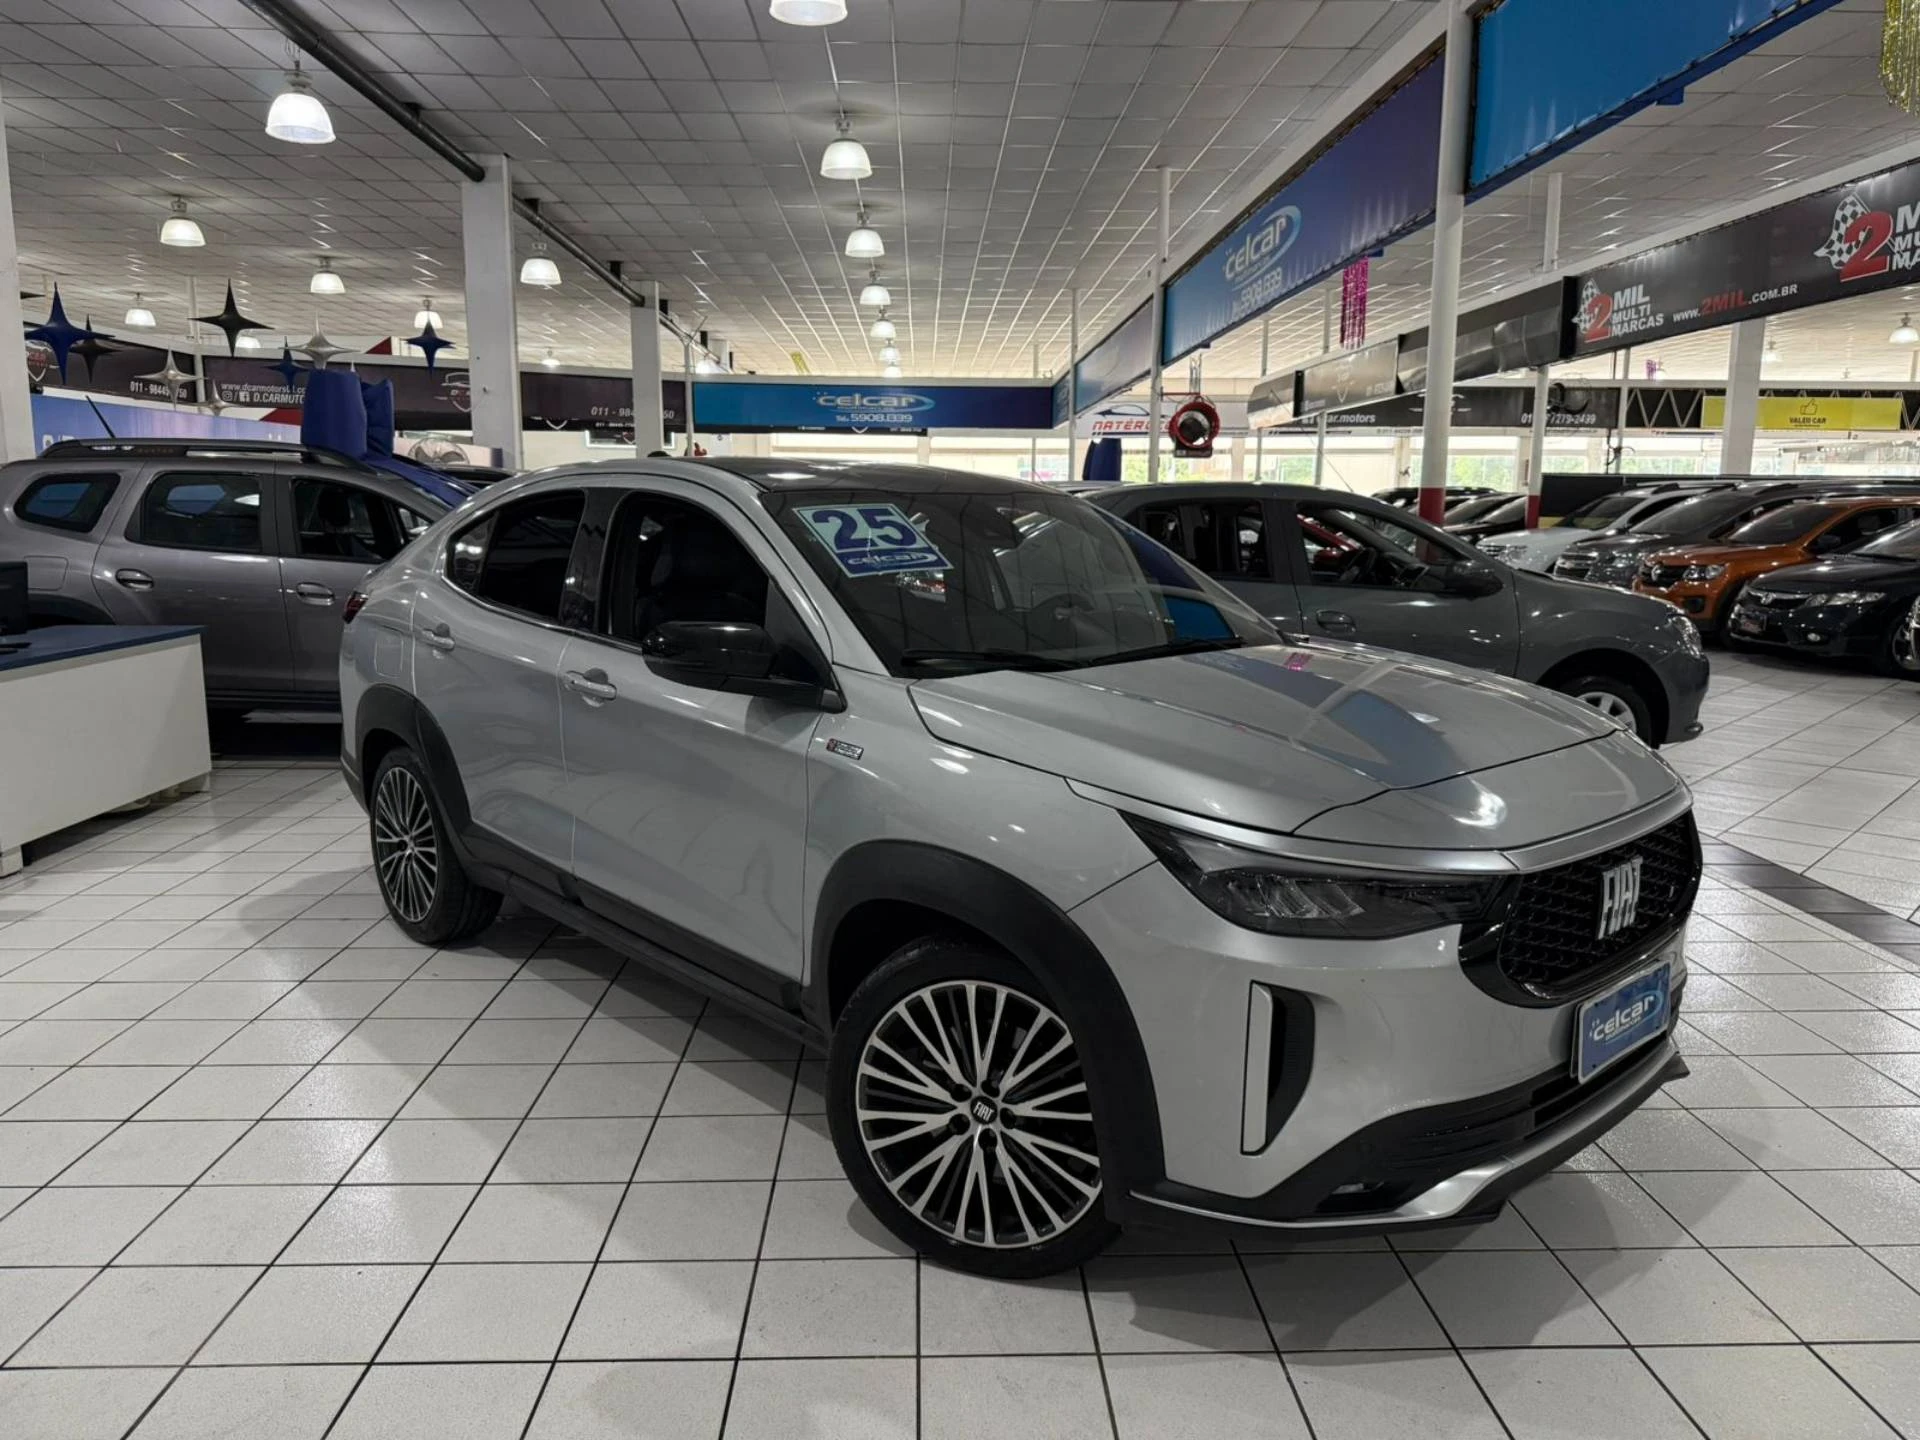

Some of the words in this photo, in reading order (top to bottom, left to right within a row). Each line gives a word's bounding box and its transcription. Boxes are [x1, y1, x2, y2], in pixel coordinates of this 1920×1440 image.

[1225, 216, 1287, 280] celcar
[1839, 211, 1893, 282] 2
[1584, 293, 1613, 343] 2
[1613, 284, 1650, 310] MIL
[1611, 303, 1651, 324] MULTI
[1611, 313, 1665, 336] MARCAS
[591, 406, 609, 416] 011
[817, 393, 914, 407] celcar
[812, 508, 917, 550] 25
[848, 553, 929, 566] celcar
[1598, 856, 1643, 940] FIAT
[1593, 993, 1655, 1041] celcar
[973, 1101, 995, 1122] FIAT
